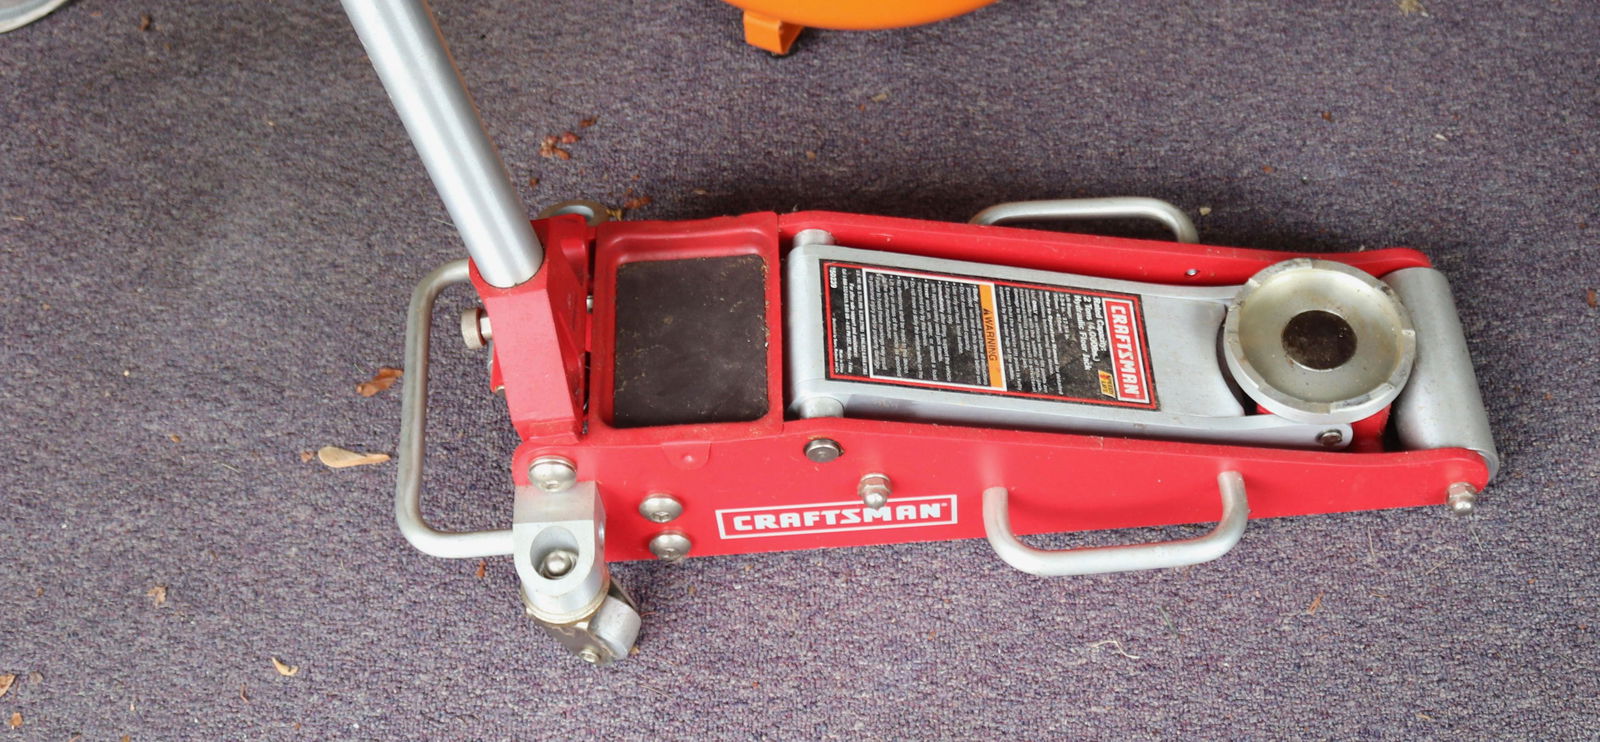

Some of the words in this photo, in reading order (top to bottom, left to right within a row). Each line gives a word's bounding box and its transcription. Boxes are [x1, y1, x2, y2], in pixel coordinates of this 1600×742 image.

[1072, 294, 1086, 329] Hydraulic
[1084, 303, 1093, 320] Tons
[1092, 296, 1103, 318] Rated
[983, 316, 997, 361] WARNING
[1078, 331, 1089, 352] Floor
[1095, 319, 1108, 352] Capacity:
[1110, 304, 1139, 394] CRAFTSMAN
[1082, 353, 1092, 370] Jack
[733, 502, 943, 531] CRAFTSMAN
